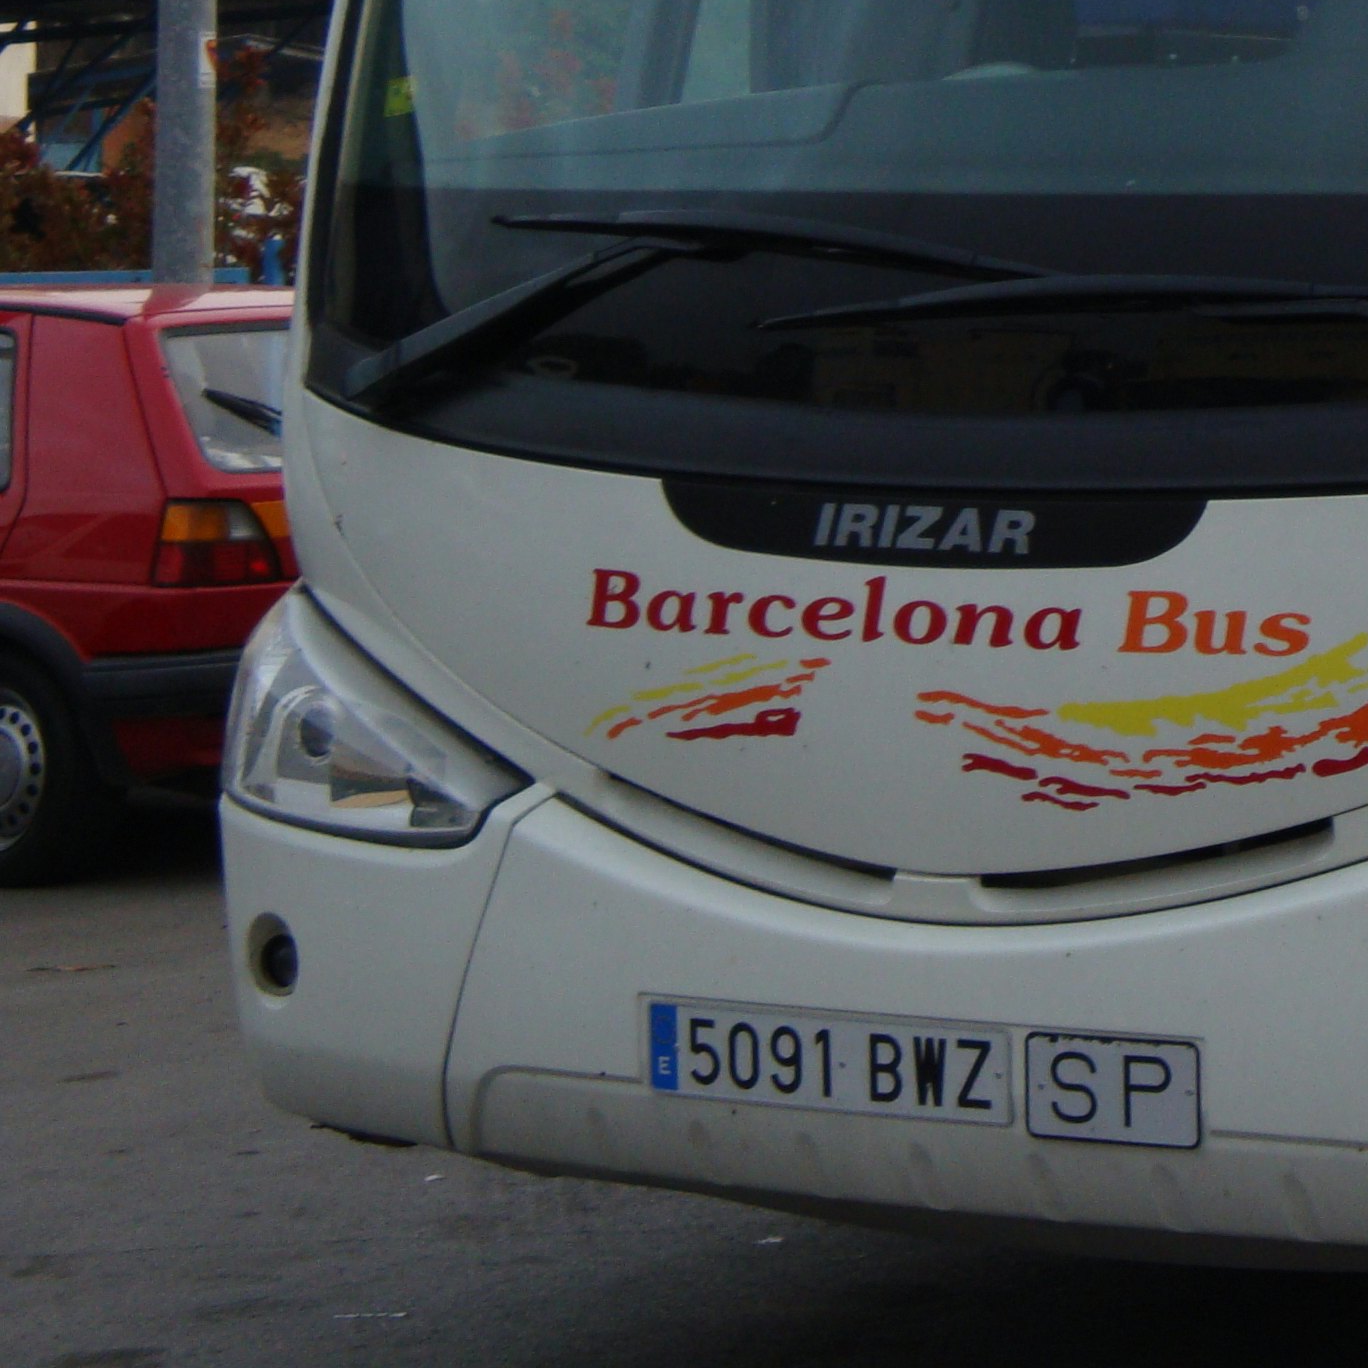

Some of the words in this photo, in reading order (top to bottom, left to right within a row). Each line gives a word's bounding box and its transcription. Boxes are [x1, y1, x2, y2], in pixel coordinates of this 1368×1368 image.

[814, 502, 1037, 556] IRIZAR
[586, 568, 1082, 651] Barcelona
[1117, 590, 1311, 657] Bus
[658, 1055, 671, 1075] E
[689, 1017, 832, 1098] 5091
[868, 1032, 993, 1111] BWZ
[1049, 1050, 1173, 1129] SP
